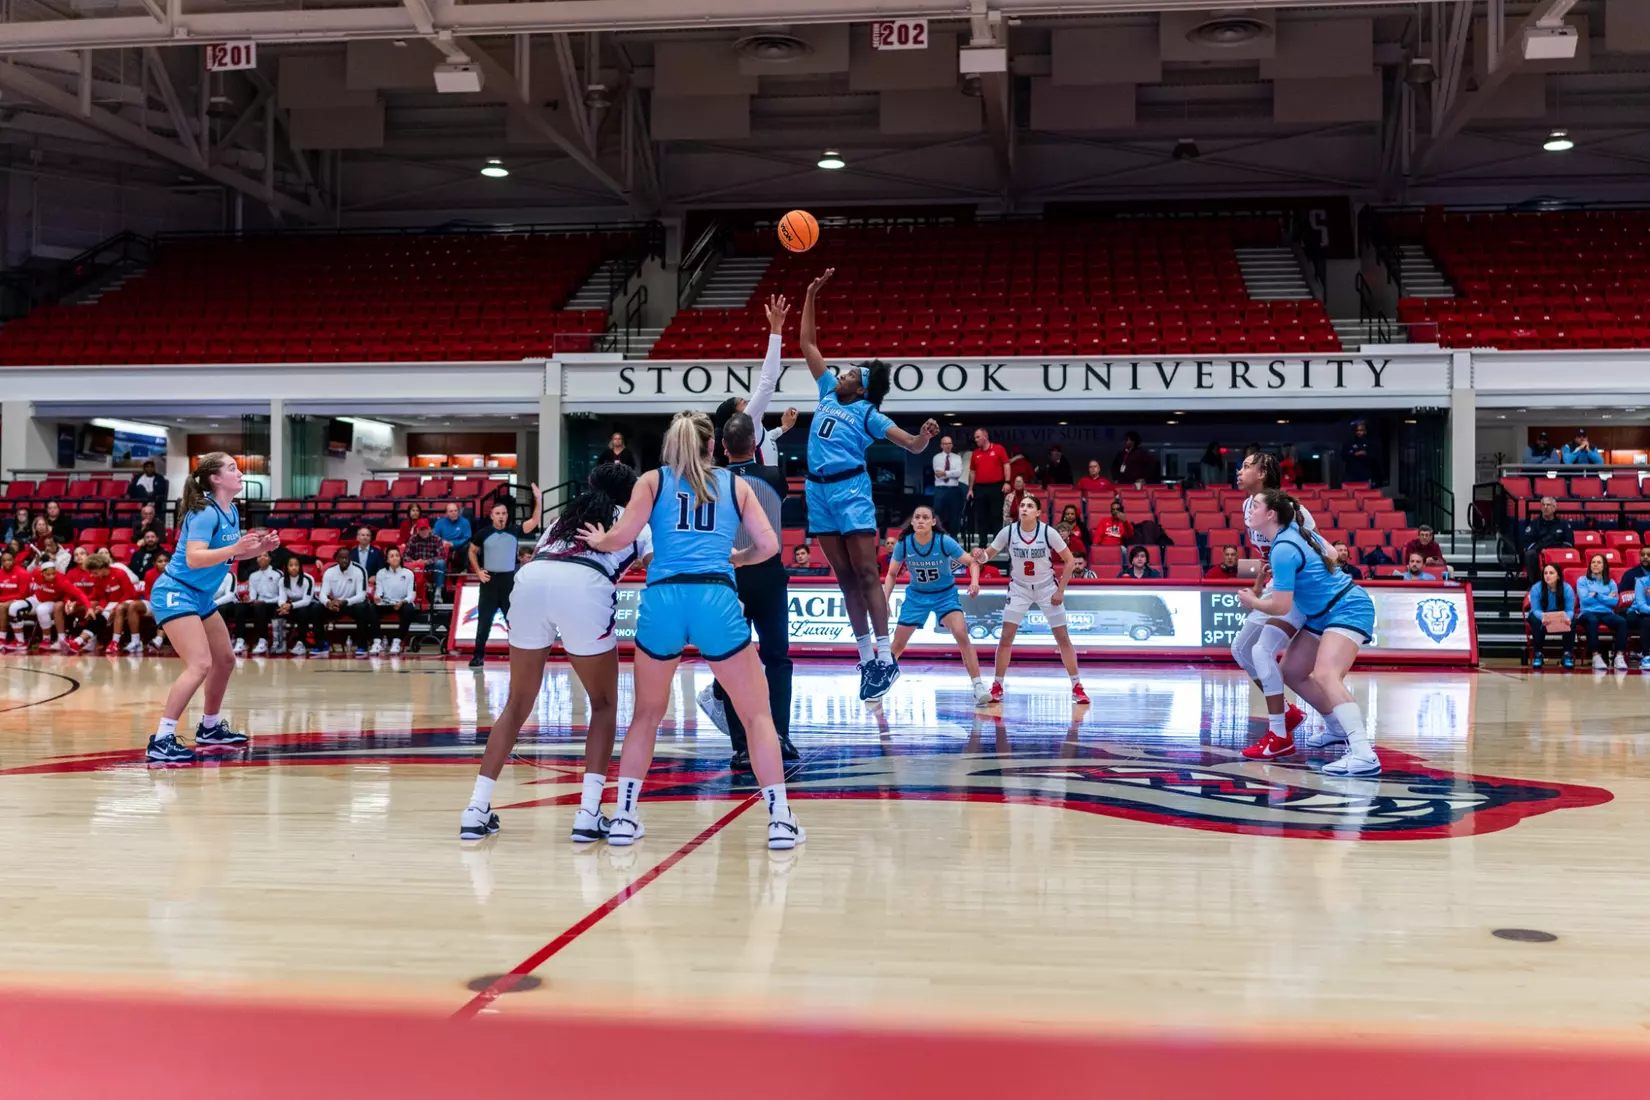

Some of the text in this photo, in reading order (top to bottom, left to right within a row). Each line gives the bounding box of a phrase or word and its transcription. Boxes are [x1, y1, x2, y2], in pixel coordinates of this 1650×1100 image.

[882, 23, 925, 46] 202
[217, 45, 251, 67] 201
[618, 365, 792, 394] STONY
[1040, 359, 1392, 392] UNIVERSITY
[817, 403, 856, 425] COLUMBIA
[817, 416, 837, 440] 0
[676, 491, 716, 533] 10
[908, 559, 943, 567] COLUMBIA
[1013, 547, 1046, 558] STONY BROOK
[915, 567, 940, 583] 35
[1023, 561, 1035, 576] 2
[166, 591, 180, 608] C
[789, 619, 843, 640] Luxury
[1213, 613, 1247, 626] FT%
